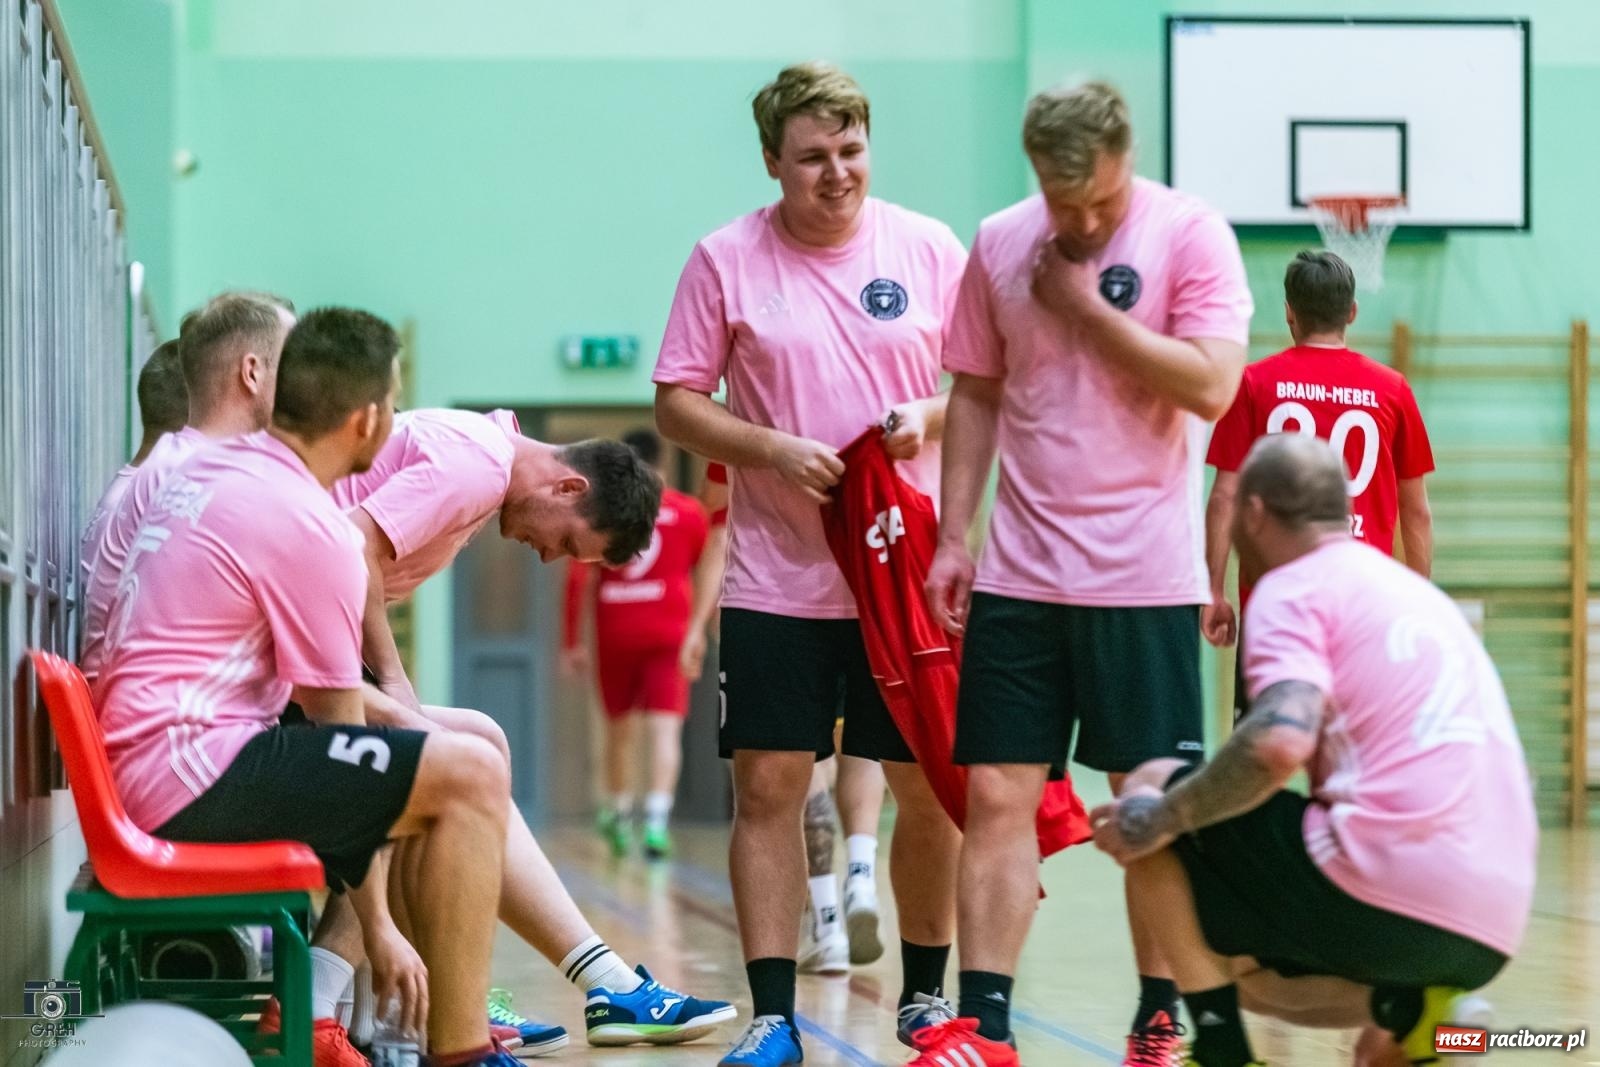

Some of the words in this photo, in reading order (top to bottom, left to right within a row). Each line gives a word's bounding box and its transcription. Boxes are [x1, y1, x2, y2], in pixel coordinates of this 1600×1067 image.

[1276, 381, 1379, 408] BRAUN-MEBEL
[1387, 612, 1486, 748] 2
[327, 732, 391, 773] 5
